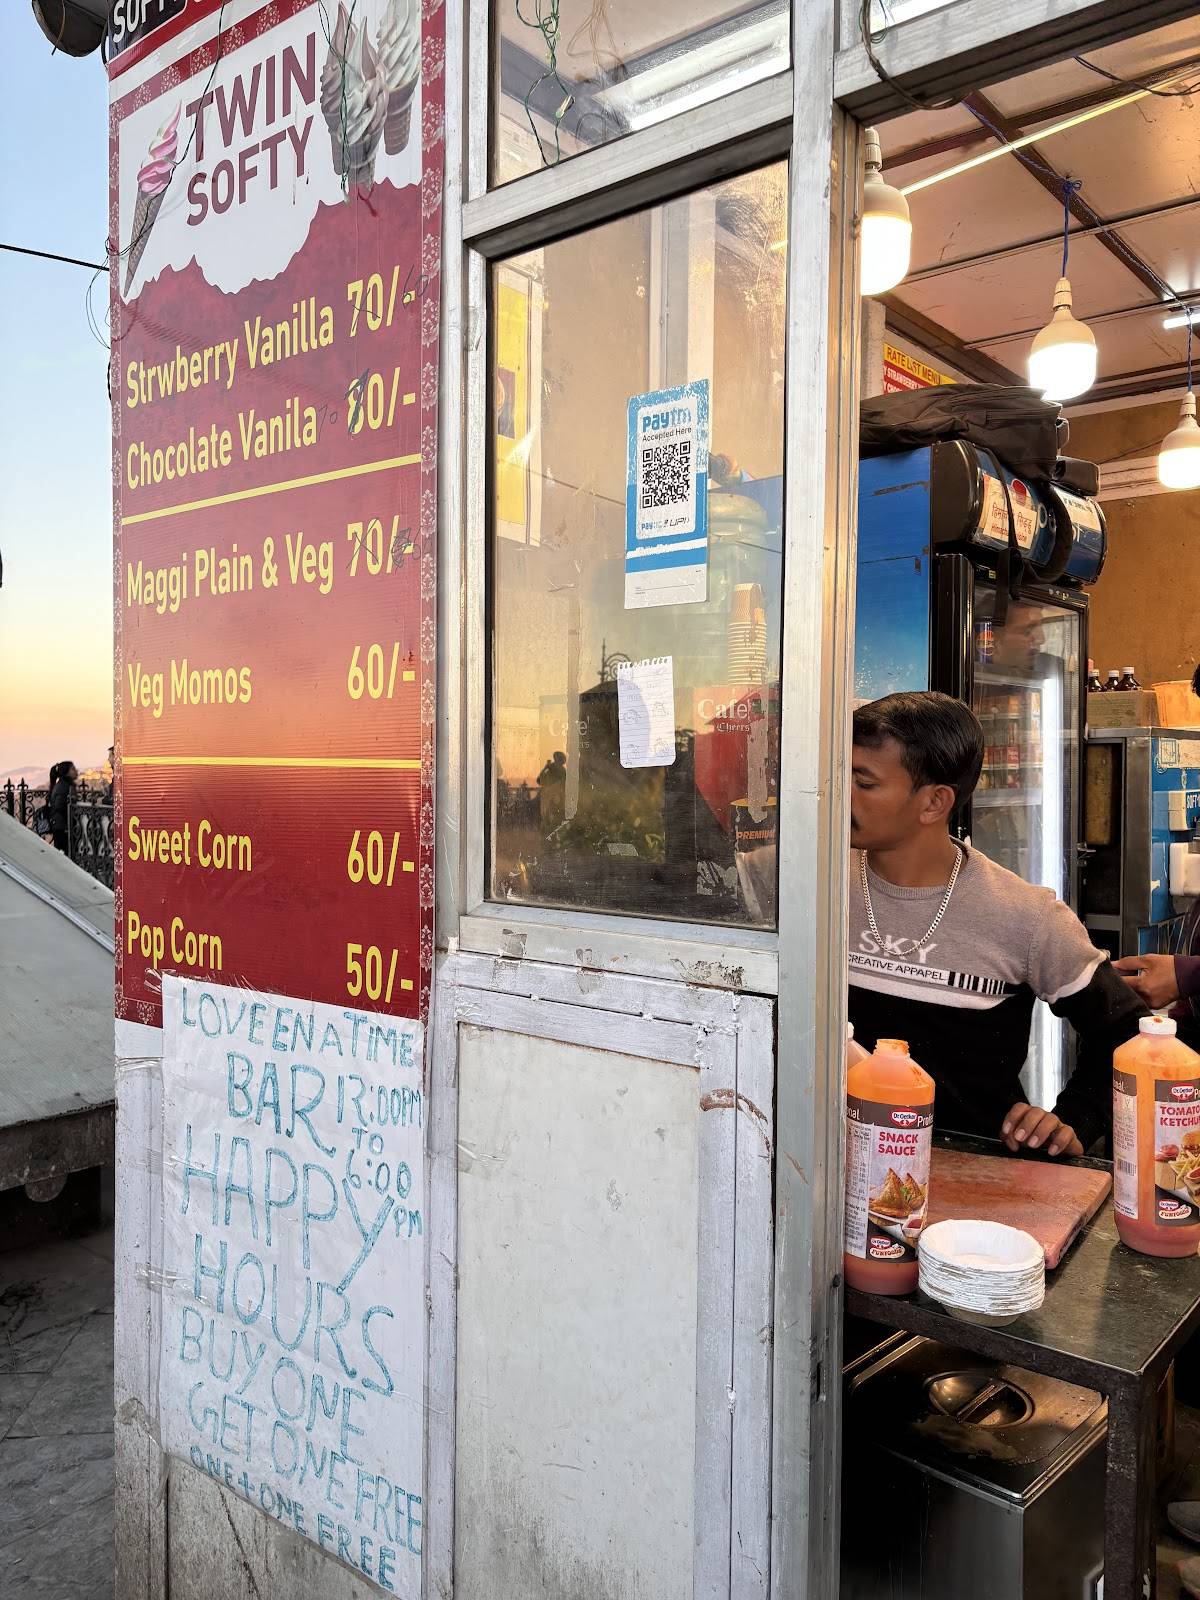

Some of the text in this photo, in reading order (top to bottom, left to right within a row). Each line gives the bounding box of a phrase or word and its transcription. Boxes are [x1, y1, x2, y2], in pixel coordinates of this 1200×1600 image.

[186, 31, 317, 163] TWIN
[186, 116, 315, 227] SOFTY
[127, 341, 238, 408] Strwberry
[244, 298, 334, 369] Vanilla
[886, 346, 906, 368] RATE
[127, 427, 232, 490] Chocolate
[238, 398, 317, 460] Vanila
[642, 427, 692, 442] Accepted Here
[127, 562, 188, 614] Maggi
[194, 547, 254, 597] Plain
[261, 542, 278, 588] &
[285, 532, 334, 594] Veg
[127, 642, 416, 719] Veg Momos 60/-
[127, 815, 416, 887] Sweet Corn 60/-
[127, 911, 415, 1003] Pop Corn 50/-
[858, 930, 938, 963] SKY
[343, 1011, 415, 1068] TIME
[226, 1051, 337, 1159] BAR
[351, 1127, 384, 1155] TO
[879, 1131, 919, 1144] SNACK
[1160, 1116, 1200, 1127] KETCHU
[346, 1150, 412, 1200] 6:00
[878, 1143, 916, 1156] SAUCE
[181, 1123, 395, 1295] HAPPY
[393, 1204, 424, 1238] PM
[193, 1233, 395, 1397] HOURS
[179, 1306, 367, 1467] BUY ONE
[188, 1381, 423, 1556] GET ONE FREE
[316, 1513, 397, 1591] FREE
